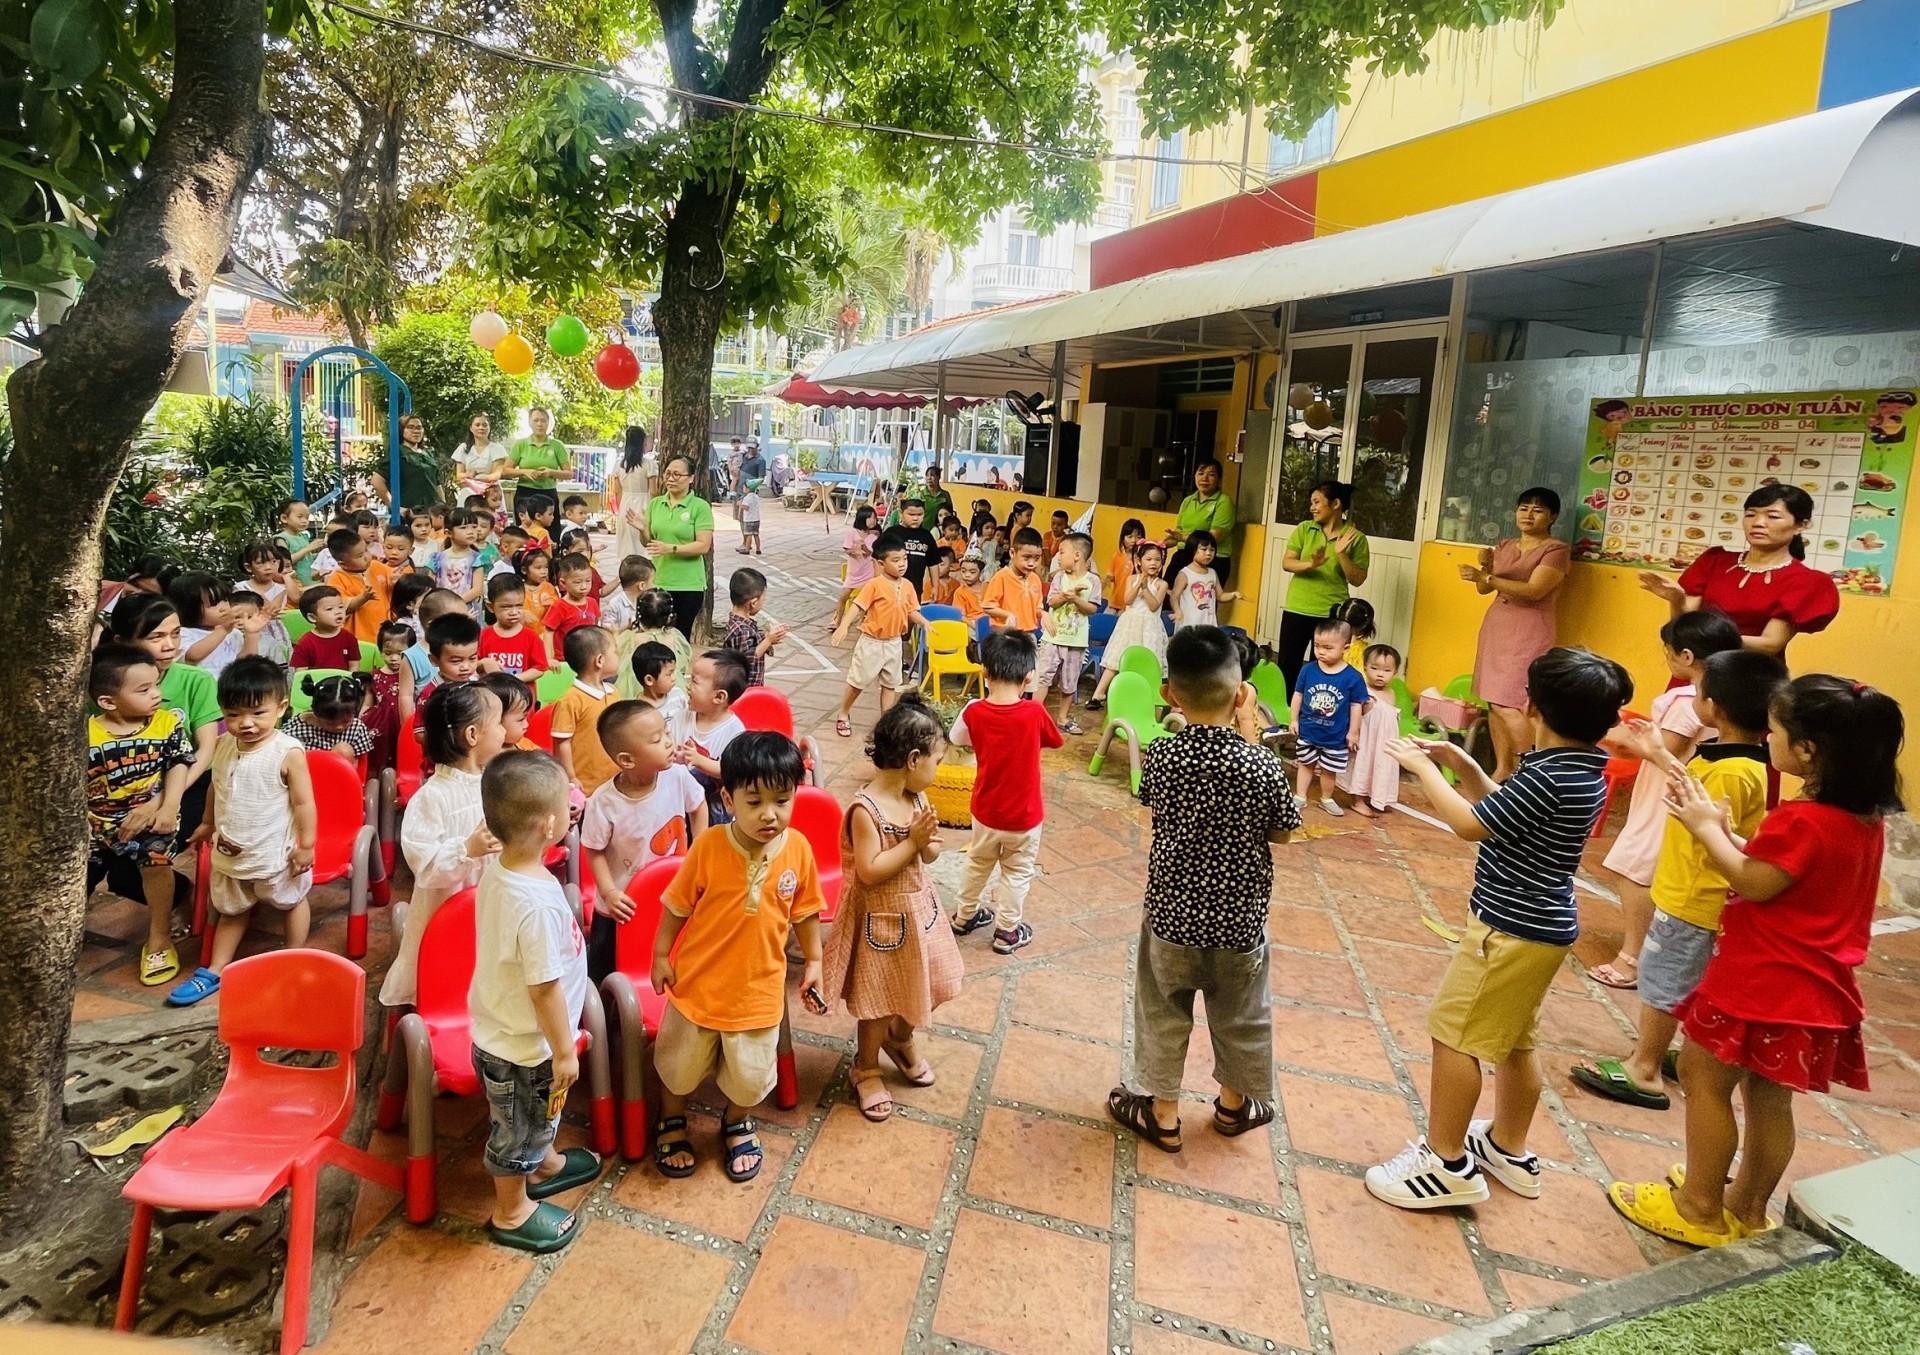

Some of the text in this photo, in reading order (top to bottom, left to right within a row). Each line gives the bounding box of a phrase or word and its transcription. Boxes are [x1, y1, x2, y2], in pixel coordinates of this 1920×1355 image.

[1634, 402, 1683, 416] BẢNG
[1689, 402, 1740, 419] THỰC
[1745, 401, 1791, 415] ĐƠN
[1680, 421, 1696, 430] 03
[1711, 421, 1728, 430] 04
[1761, 420, 1779, 429] 08
[1798, 420, 1815, 429] 04
[488, 652, 524, 667] ESUS
